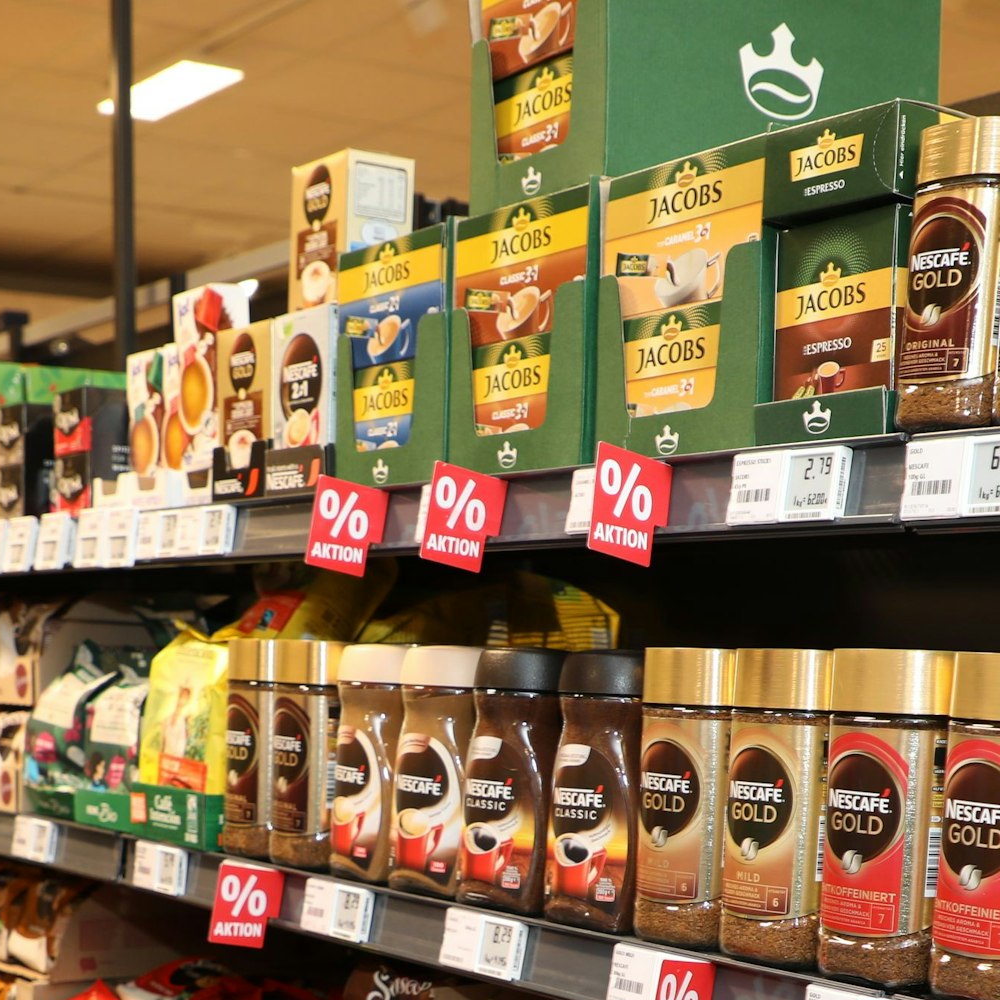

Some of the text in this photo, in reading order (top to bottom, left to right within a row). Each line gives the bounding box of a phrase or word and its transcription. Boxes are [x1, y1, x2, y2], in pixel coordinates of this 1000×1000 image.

[514, 84, 573, 126] JACOBS
[795, 144, 857, 176] JACOBS
[807, 179, 845, 196] ESPRESSO
[647, 180, 722, 224] JACOBS
[491, 226, 552, 264] JACOBS
[910, 242, 971, 273] NESCAFÉ
[363, 261, 410, 293] JACOBS
[912, 269, 963, 291] GOLD
[795, 282, 867, 319] JACOBS
[635, 337, 706, 374] JACOBS
[806, 337, 852, 356] ESPRESSO
[876, 341, 887, 352] 25
[905, 338, 955, 351] ORIGINAL
[952, 358, 960, 367] 7
[484, 364, 541, 398] JACOBS
[361, 388, 409, 416] JACOBS
[804, 456, 833, 481] 2.79
[600, 459, 653, 522] %
[319, 489, 369, 541] %
[435, 475, 486, 532] %
[427, 533, 480, 558] AKTION
[593, 522, 648, 551] AKTION
[311, 541, 363, 564] AKTION
[641, 770, 691, 795] NESCAFÉ
[730, 778, 784, 803] NESCAFÉ
[466, 797, 506, 811] CLASSIC
[642, 792, 686, 814] GOLD
[731, 801, 778, 824] GOLD
[829, 787, 891, 814] NESCAFÉ
[555, 808, 598, 821] CLASSIC
[831, 811, 884, 836] GOLD
[681, 882, 688, 892] 6
[736, 870, 761, 883] MILD
[221, 874, 268, 917] %
[772, 897, 779, 907] 6
[214, 921, 263, 937] AKTION
[879, 913, 885, 924] 7
